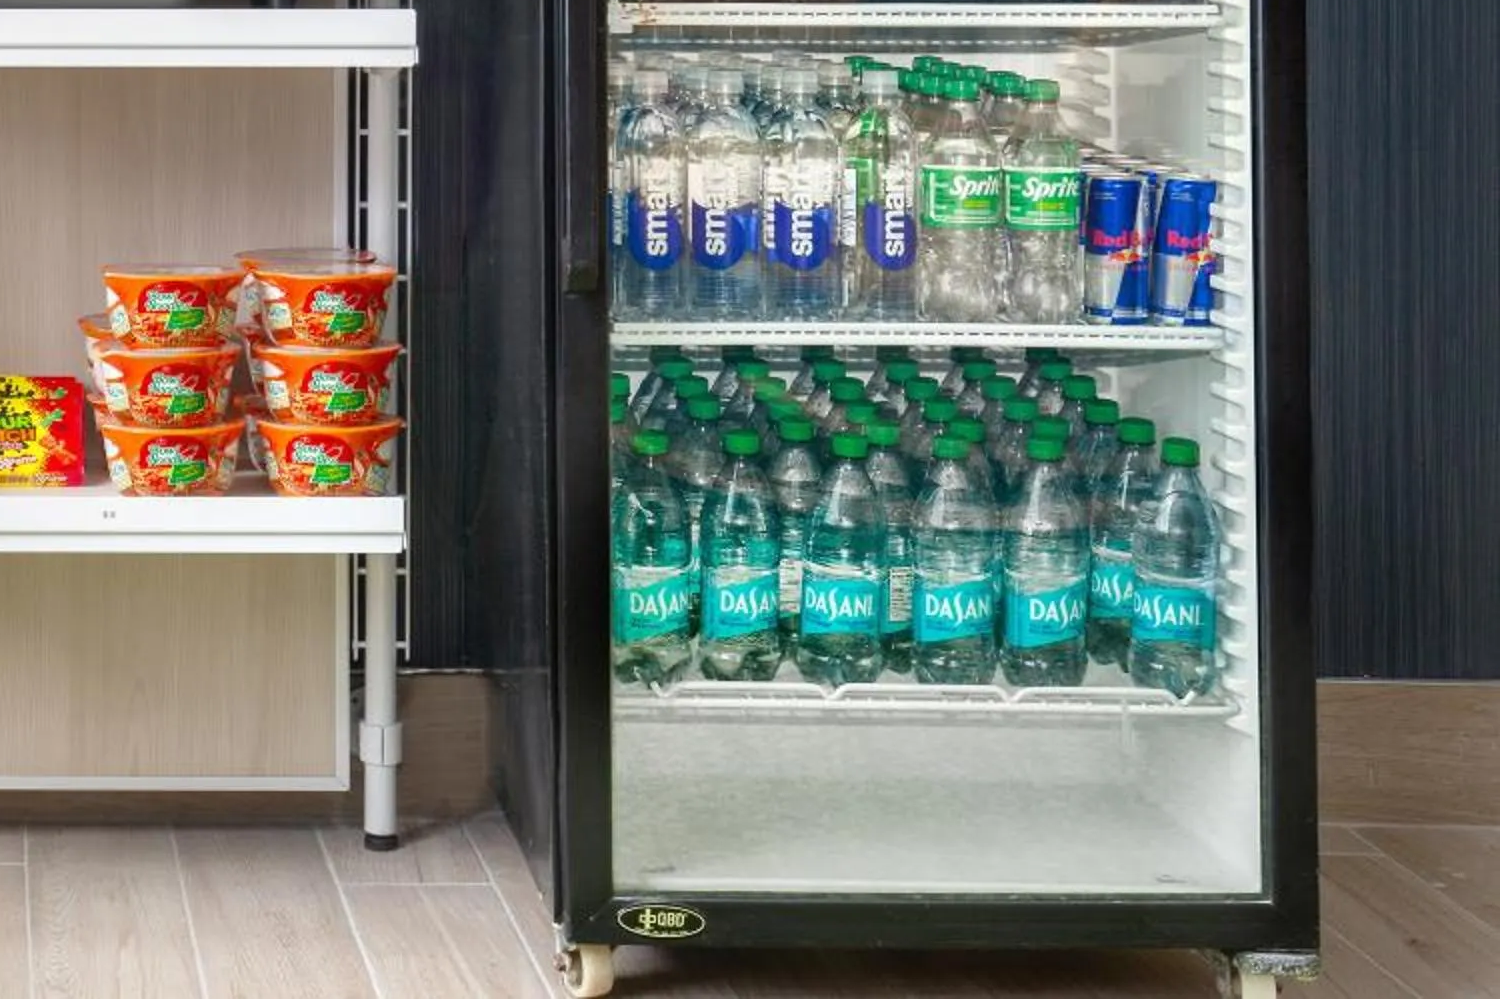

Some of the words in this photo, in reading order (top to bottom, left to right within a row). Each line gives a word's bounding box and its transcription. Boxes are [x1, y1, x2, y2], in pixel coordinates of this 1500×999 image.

[1092, 229, 1128, 247] Red
[1166, 229, 1204, 250] Red
[804, 585, 875, 620] DASANI
[925, 591, 991, 626] DASAN
[1133, 592, 1204, 627] DASANI
